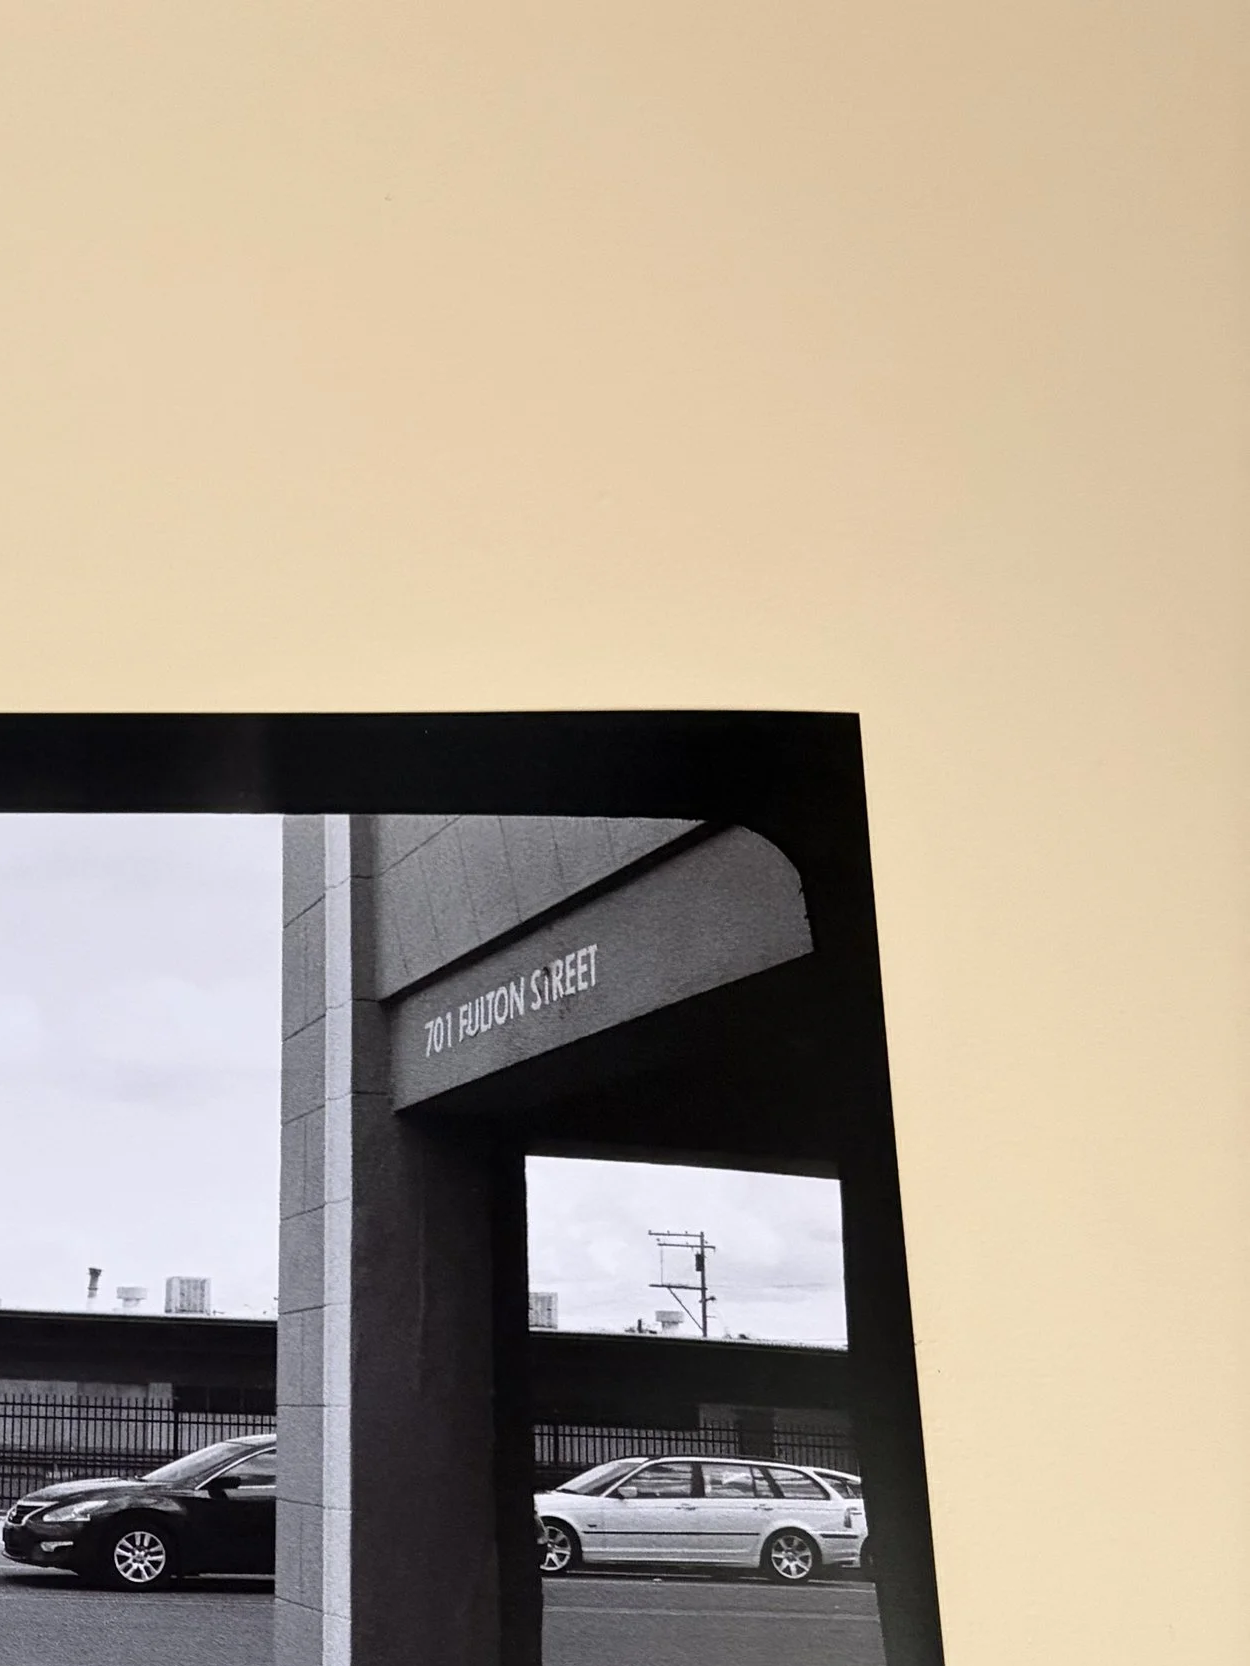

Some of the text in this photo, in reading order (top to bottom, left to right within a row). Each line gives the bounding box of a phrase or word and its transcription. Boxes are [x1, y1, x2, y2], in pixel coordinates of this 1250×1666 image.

[424, 944, 598, 1058] 701 FULTON STREET
